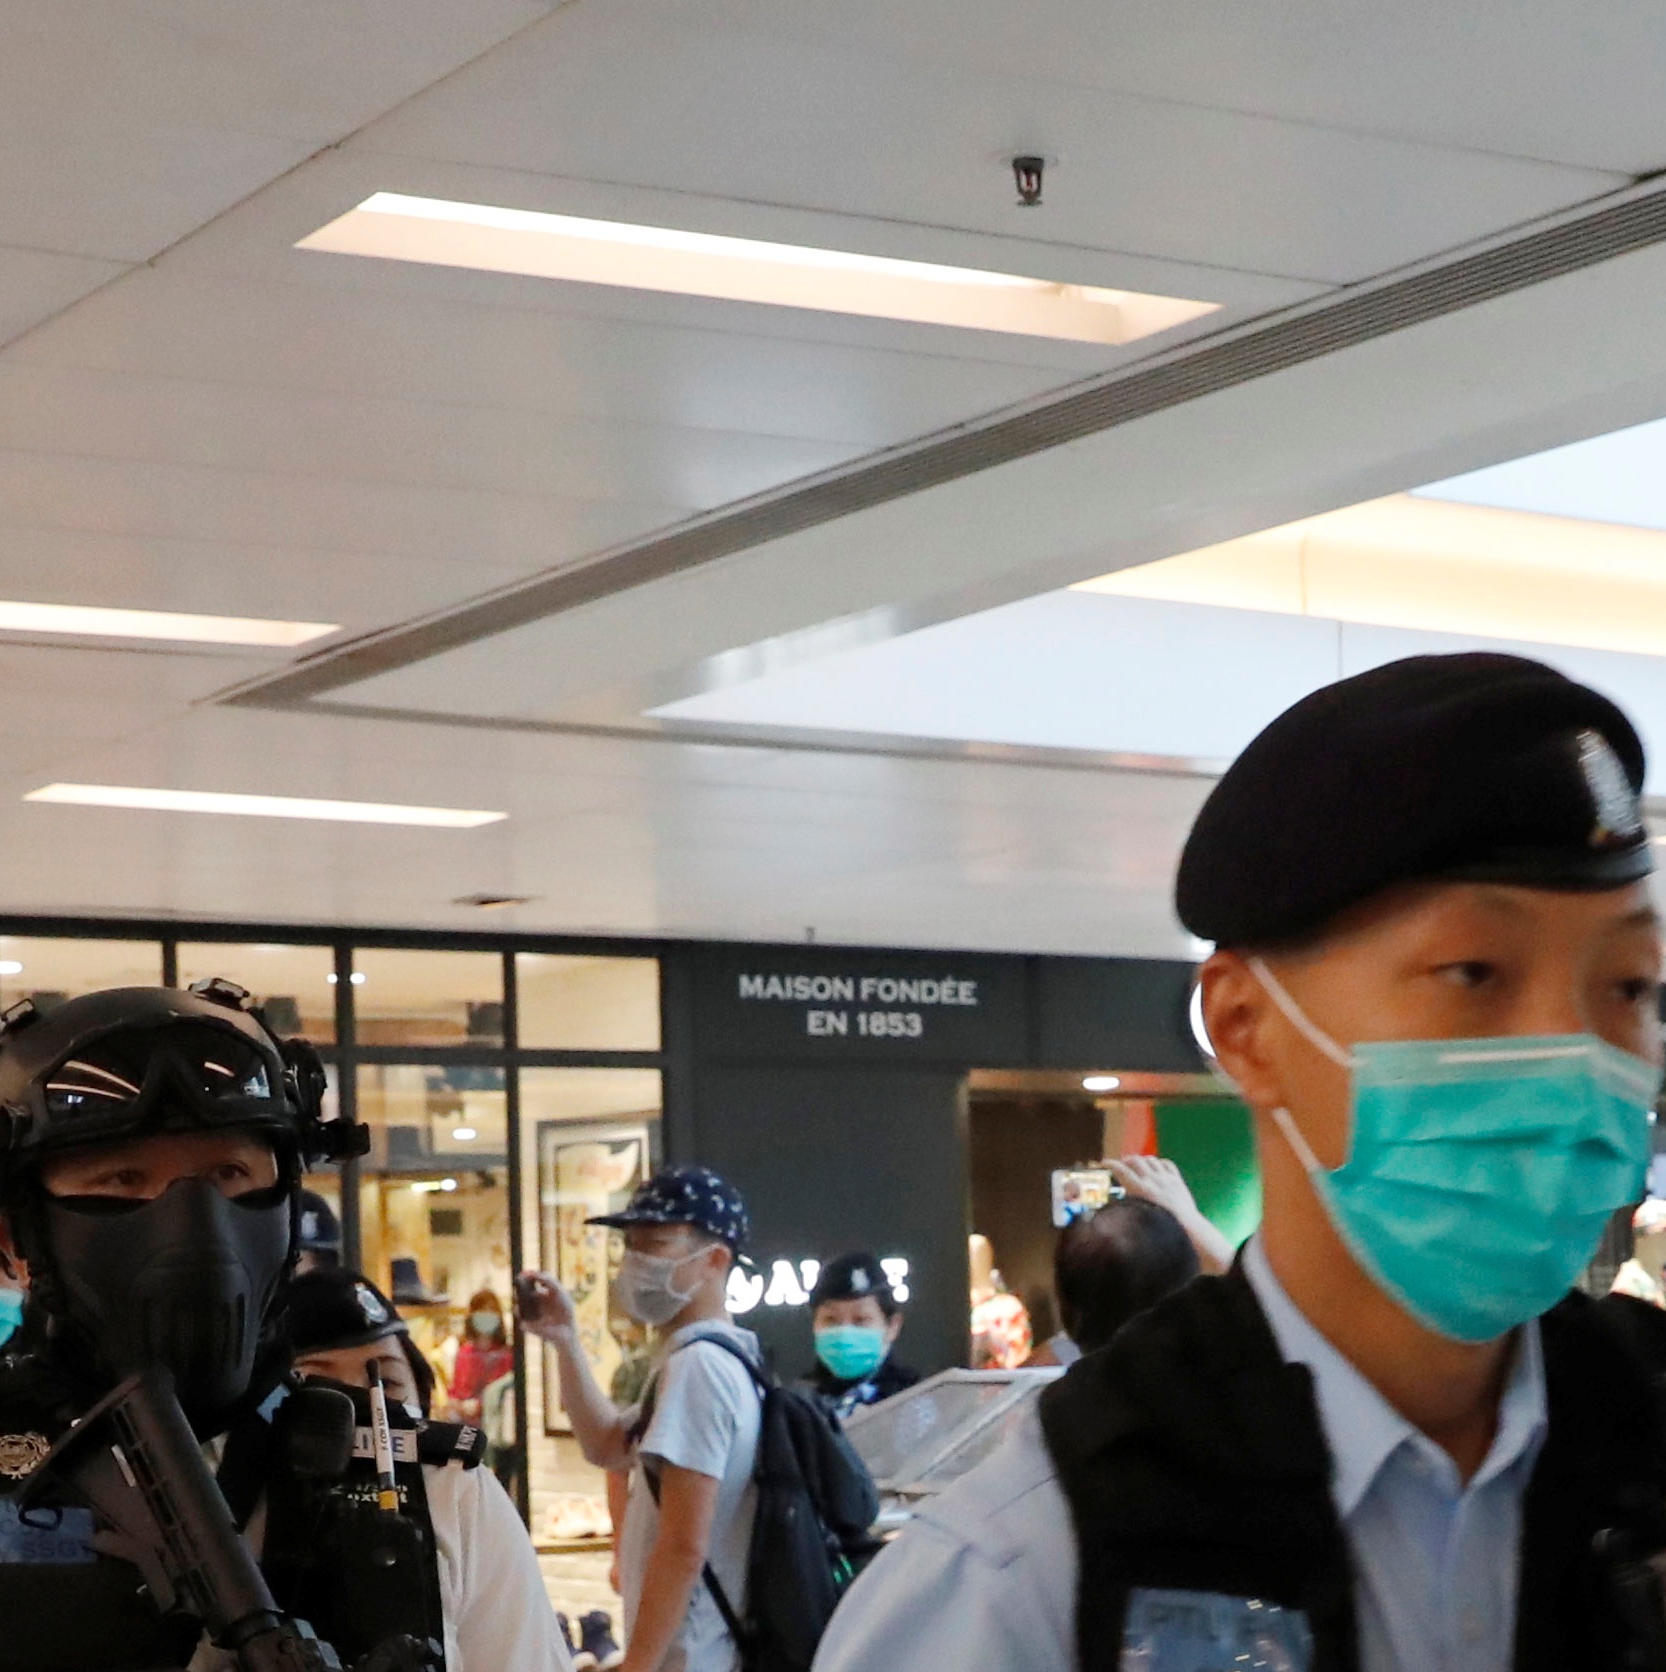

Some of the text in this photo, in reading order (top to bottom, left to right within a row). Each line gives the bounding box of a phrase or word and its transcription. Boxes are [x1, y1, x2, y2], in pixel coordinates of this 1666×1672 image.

[738, 974, 978, 1006] MAISON FONDÉE
[807, 1010, 924, 1038] EN 1853
